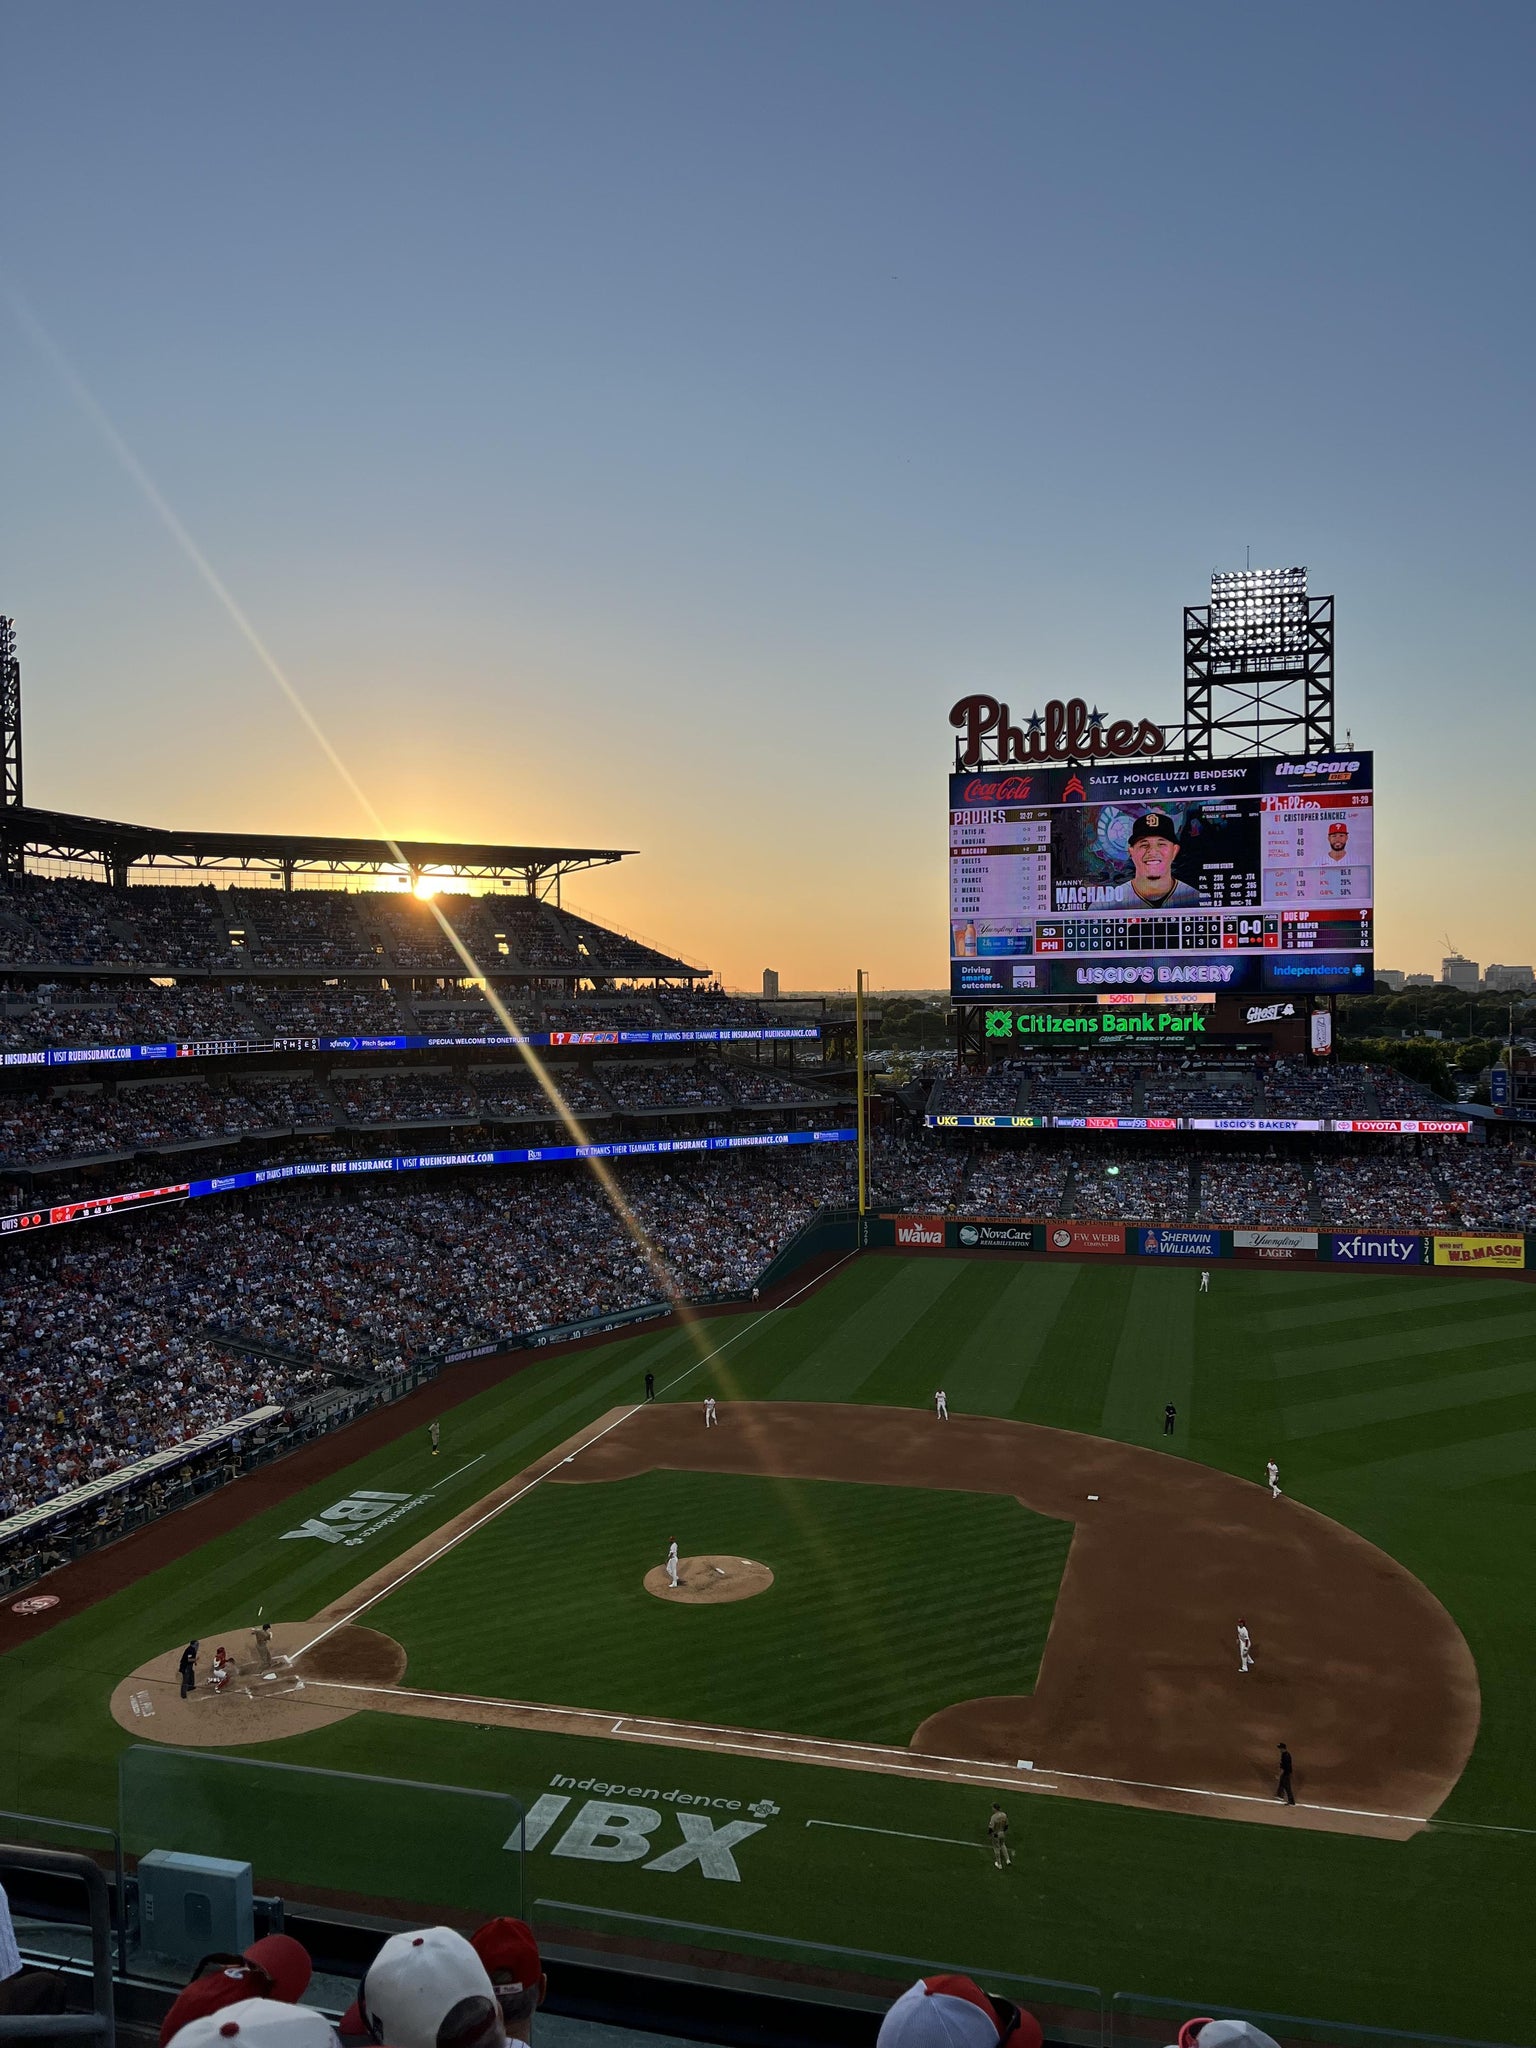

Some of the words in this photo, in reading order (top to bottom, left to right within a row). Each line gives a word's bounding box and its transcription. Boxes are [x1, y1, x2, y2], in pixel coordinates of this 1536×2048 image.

[949, 694, 1165, 767] Phillies
[1275, 761, 1360, 776] theScore
[1089, 775, 1119, 785] SALTZ
[1123, 771, 1189, 783] MONGELUZZI
[1193, 768, 1248, 780] BENDESKY
[964, 776, 1034, 802] Coca-Cola
[1119, 787, 1159, 796] INJURY
[1166, 784, 1217, 793] LAWYERS
[1262, 796, 1321, 811] Phillies
[953, 810, 1006, 825] PADRES
[1283, 812, 1319, 822] CRISTOPHER
[1320, 811, 1346, 821] SÁNCHEZ
[1056, 886, 1123, 904] MACHADO
[1283, 911, 1298, 921] DUE
[1299, 911, 1310, 921] UP
[1042, 928, 1056, 936] SD
[1240, 920, 1261, 935] 0-0
[1041, 941, 1058, 949] PHI
[961, 966, 991, 975] Driving
[1076, 967, 1154, 984] LISCIO'S
[1158, 965, 1234, 982] BAKERY
[1273, 965, 1350, 977] Independence
[961, 974, 993, 982] smarter
[1247, 1003, 1285, 1022] GHOST
[1016, 1013, 1099, 1033] Citizens
[1102, 1012, 1155, 1032] Bank
[1158, 1012, 1207, 1032] Park
[719, 1030, 731, 1039] RUE
[731, 1030, 762, 1039] INSURANCE
[764, 1029, 817, 1038] RUEINSURANCE.COM
[329, 1039, 351, 1049] xfinity
[379, 1039, 396, 1047] Speed
[455, 1037, 486, 1045] WELCOME
[5, 1052, 45, 1065] INSURANCE
[53, 1051, 67, 1063] VISIT
[68, 1048, 132, 1062] RUEINSURANCE.COM
[936, 1116, 959, 1125] UKG
[973, 1117, 996, 1126] UKG
[1011, 1117, 1034, 1126] UKG
[1088, 1119, 1115, 1128] NECA
[1149, 1120, 1176, 1129] NECA
[1215, 1120, 1257, 1128] LISCIO'S
[1259, 1121, 1298, 1129] BAKERY
[1355, 1122, 1398, 1131] TOYOTA
[1422, 1123, 1465, 1132] TOYOTA
[590, 1146, 611, 1156] THANKS
[612, 1145, 628, 1154] THEIR
[658, 1142, 671, 1151] RUE
[672, 1140, 708, 1150] INSURANCE
[715, 1139, 728, 1148] VISIT
[729, 1135, 789, 1146] RUEINSURANCE.COM
[402, 1158, 418, 1168] VISIT
[419, 1153, 494, 1167] RUEINSURANCE.COM
[294, 1164, 329, 1176] TEAMMATE:
[330, 1162, 347, 1173] RUE
[349, 1160, 393, 1171] INSURANCE
[2, 1218, 18, 1230] OUTS
[898, 1228, 943, 1244] Wawa
[979, 1227, 1032, 1241] NovaCare
[1092, 1233, 1120, 1242] WEBB
[1161, 1230, 1211, 1243] SHERWIN
[1249, 1232, 1303, 1248] Yuengling
[1258, 1249, 1293, 1258] LAGER
[1337, 1236, 1414, 1260] xfinity
[444, 1350, 472, 1363] LISCIO'S
[472, 1344, 498, 1357] BAKERY
[278, 1490, 413, 1544] IBX
[549, 1774, 741, 1810] Independence
[502, 1793, 768, 1882] IBX
